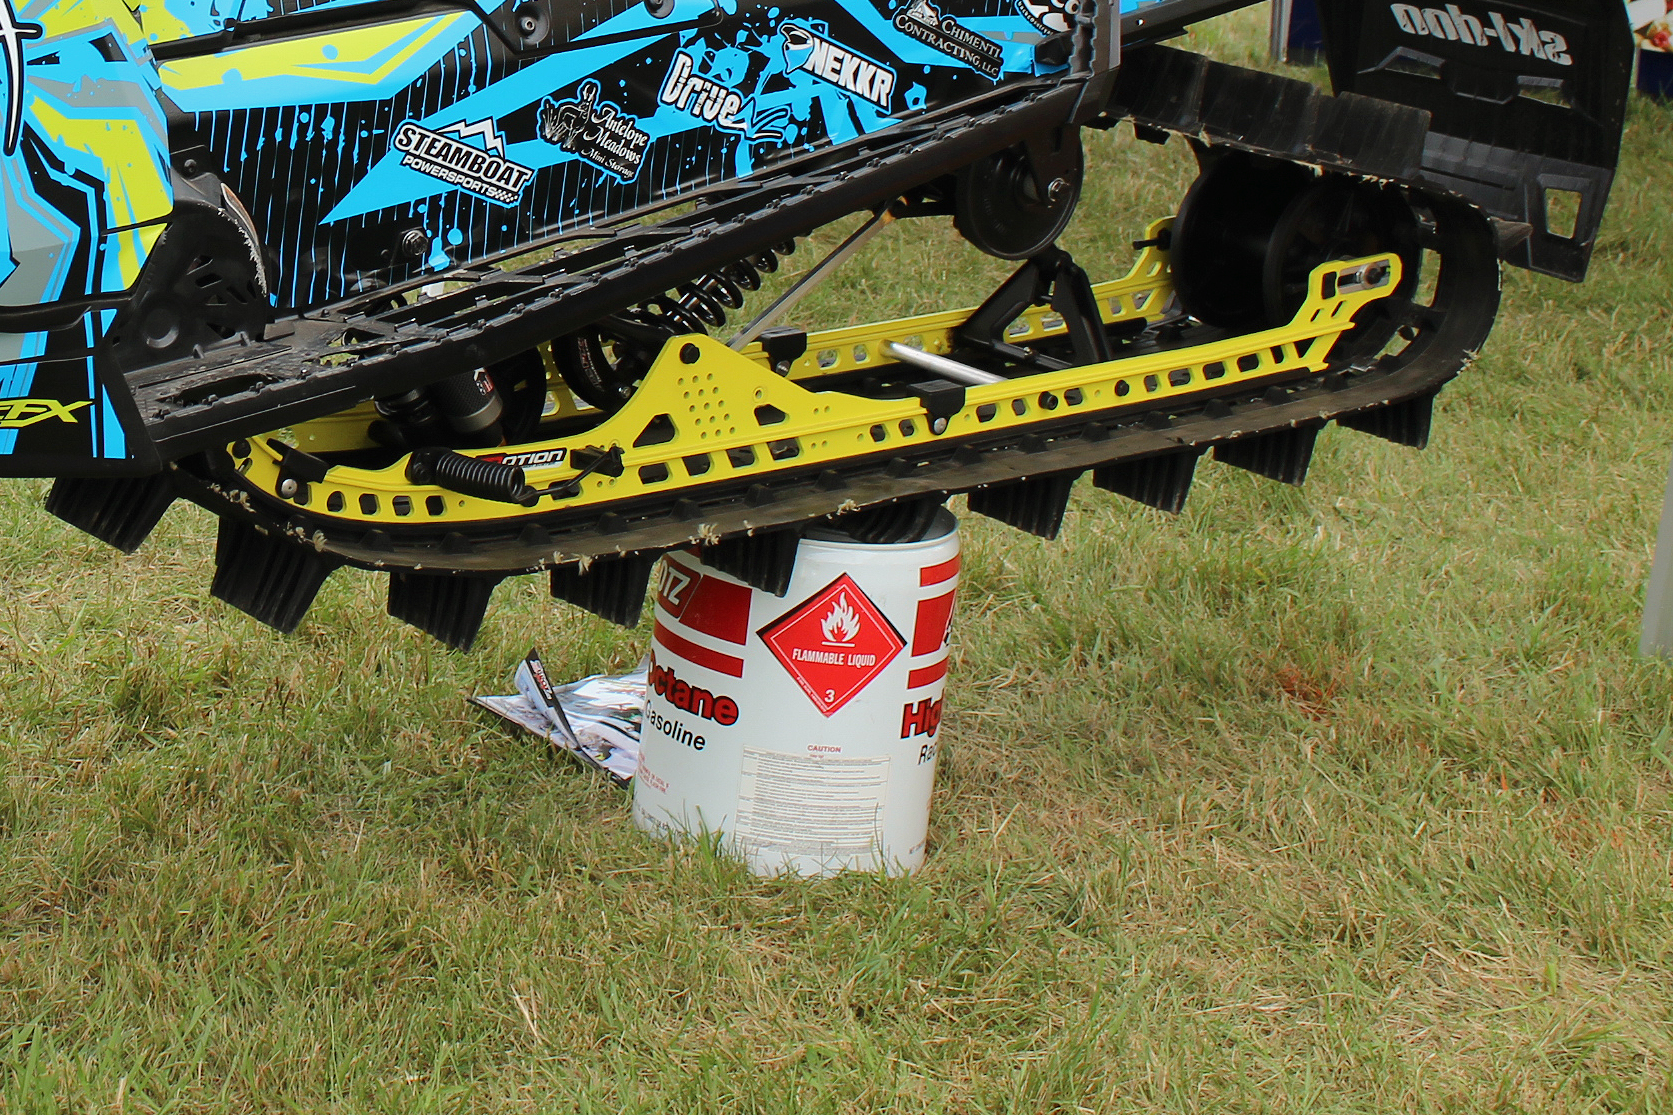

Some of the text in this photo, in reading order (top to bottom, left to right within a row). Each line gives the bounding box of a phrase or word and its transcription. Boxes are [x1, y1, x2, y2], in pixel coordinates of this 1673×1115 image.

[941, 16, 1002, 59] CHIMENTI
[804, 36, 895, 108] NEKKR
[981, 63, 1000, 77] LLC
[583, 127, 643, 165] Meadows
[591, 106, 649, 148] Antelope
[395, 124, 533, 193] STEAMBOAT
[402, 155, 497, 197] POWERSPORTS
[581, 147, 636, 180] Mini Storage
[791, 648, 876, 669] FLAMMABLE LIQUID
[824, 688, 836, 703] 3
[645, 698, 707, 752] Gasoline
[806, 743, 842, 753] CAUTION
